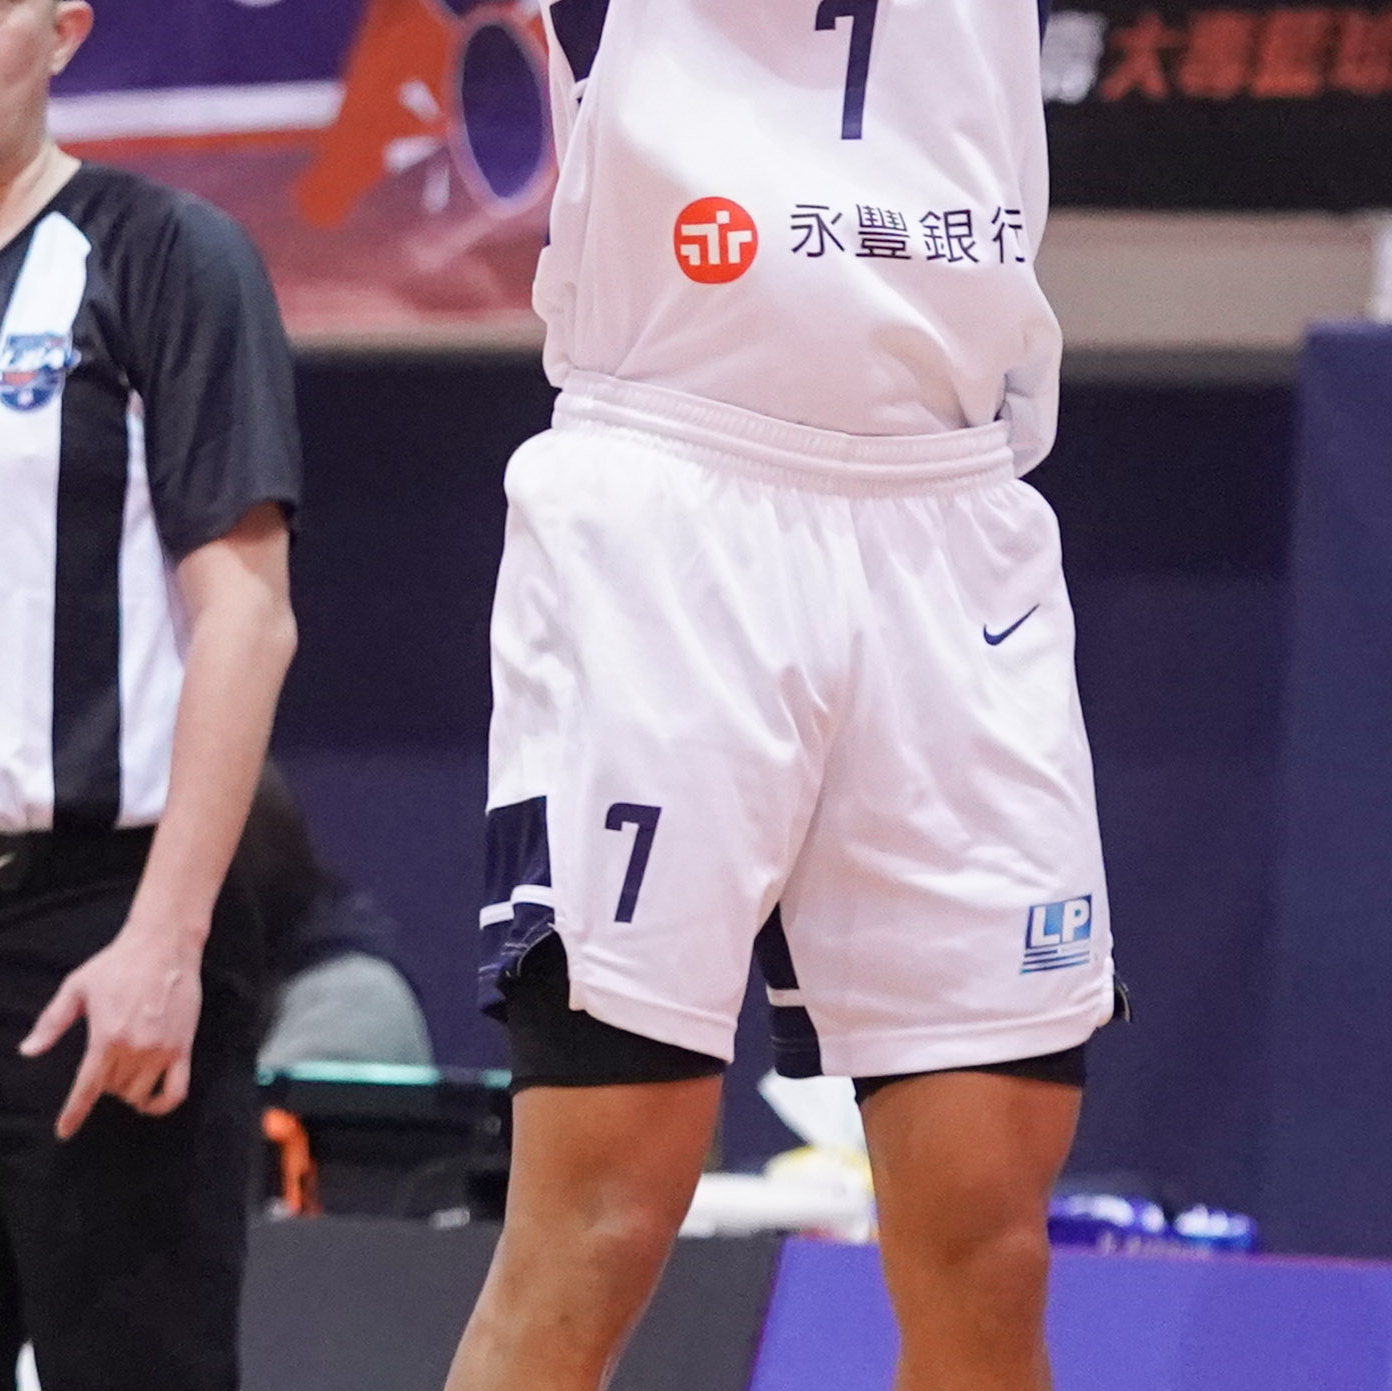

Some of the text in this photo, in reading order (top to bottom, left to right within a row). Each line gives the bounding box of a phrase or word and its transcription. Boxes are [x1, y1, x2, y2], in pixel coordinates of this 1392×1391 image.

[789, 203, 1026, 264] 永豐銀行
[604, 801, 663, 924] 7
[1029, 897, 1091, 948] LP
